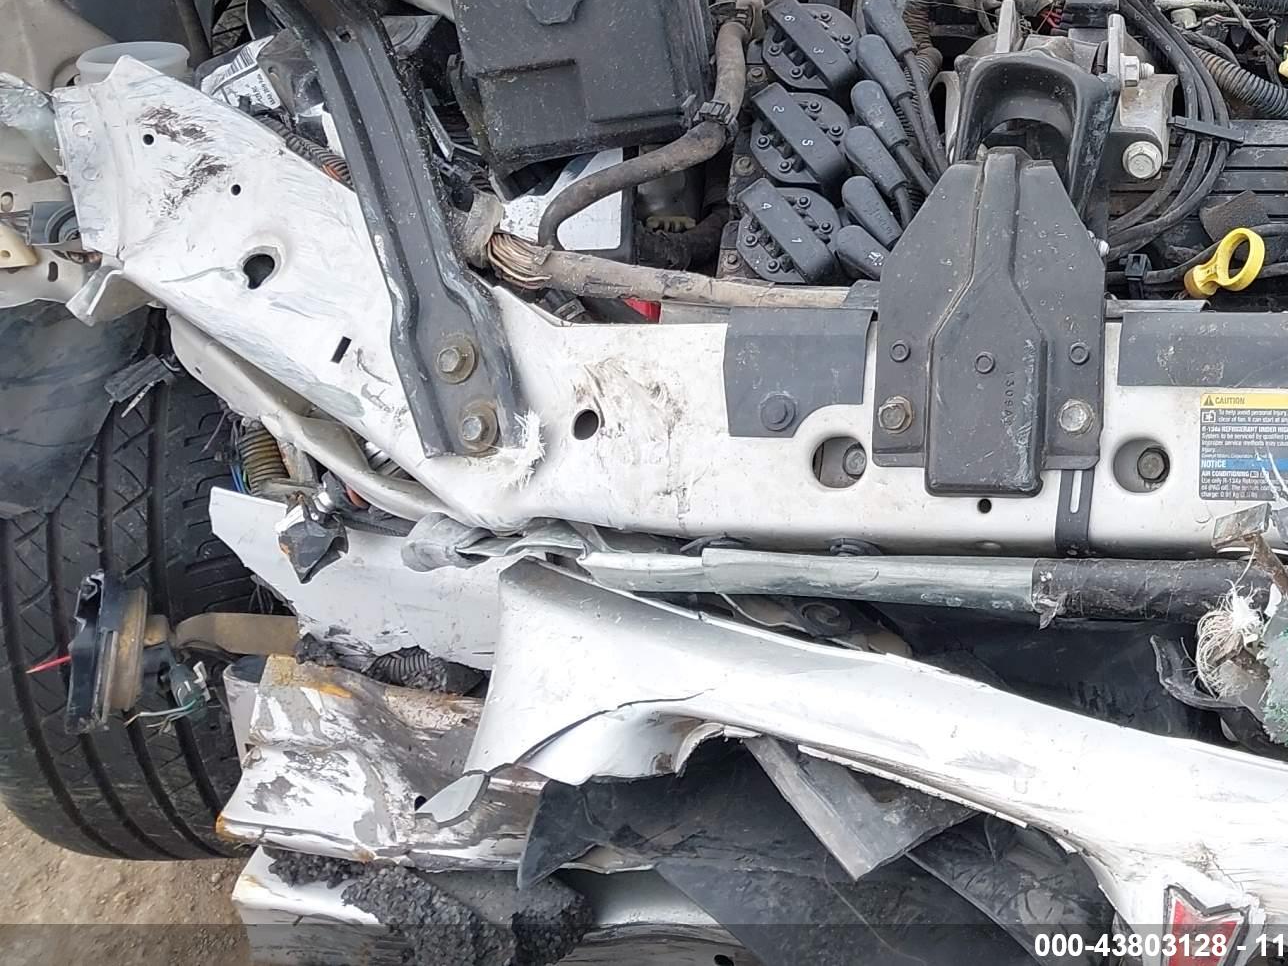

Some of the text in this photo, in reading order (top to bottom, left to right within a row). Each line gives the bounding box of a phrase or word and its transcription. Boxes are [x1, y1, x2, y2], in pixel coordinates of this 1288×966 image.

[784, 15, 795, 23] 6
[813, 46, 825, 54] 3
[773, 105, 784, 114] 2
[1215, 397, 1245, 405] CAUTION
[1202, 460, 1226, 468] NOTICE
